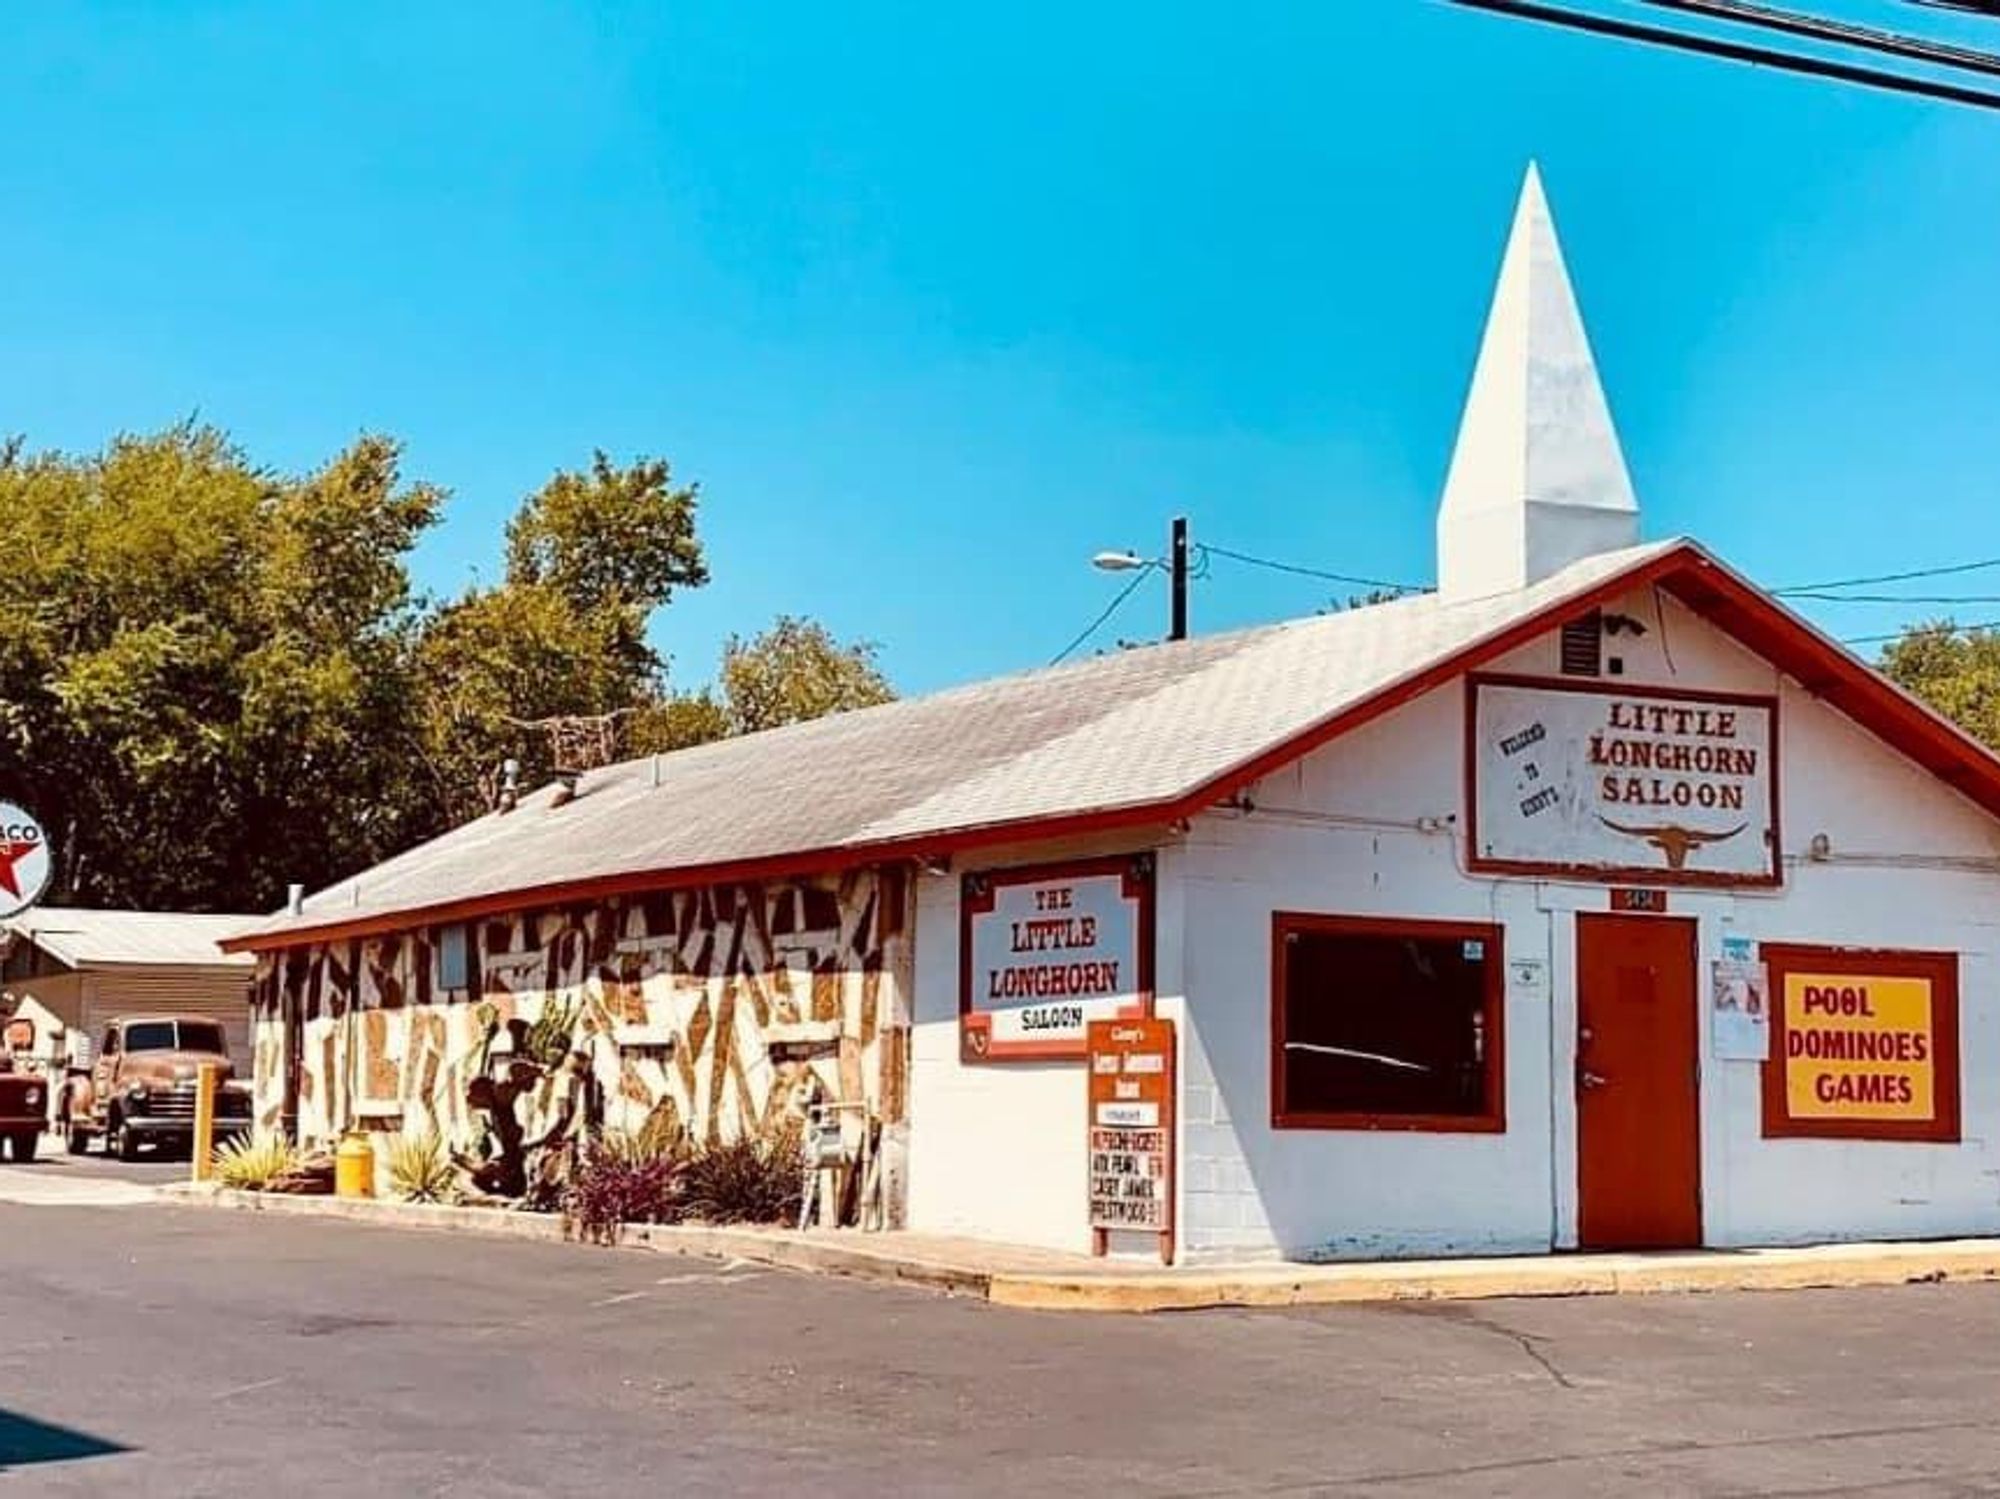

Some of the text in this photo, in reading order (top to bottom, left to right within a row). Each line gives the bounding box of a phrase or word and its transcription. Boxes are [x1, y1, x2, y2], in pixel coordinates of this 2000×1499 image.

[1609, 703, 1736, 737] LITTLE
[1588, 736, 1757, 776] LONGHORN
[1603, 776, 1743, 810] SALOON
[1036, 888, 1072, 911] THE
[1011, 916, 1096, 952] LITTLE
[989, 962, 1119, 999] LONGHORN
[1021, 1006, 1083, 1030] SALOON
[1788, 1030, 1927, 1062] DOMINOES
[1815, 1073, 1912, 1104] GAMES
